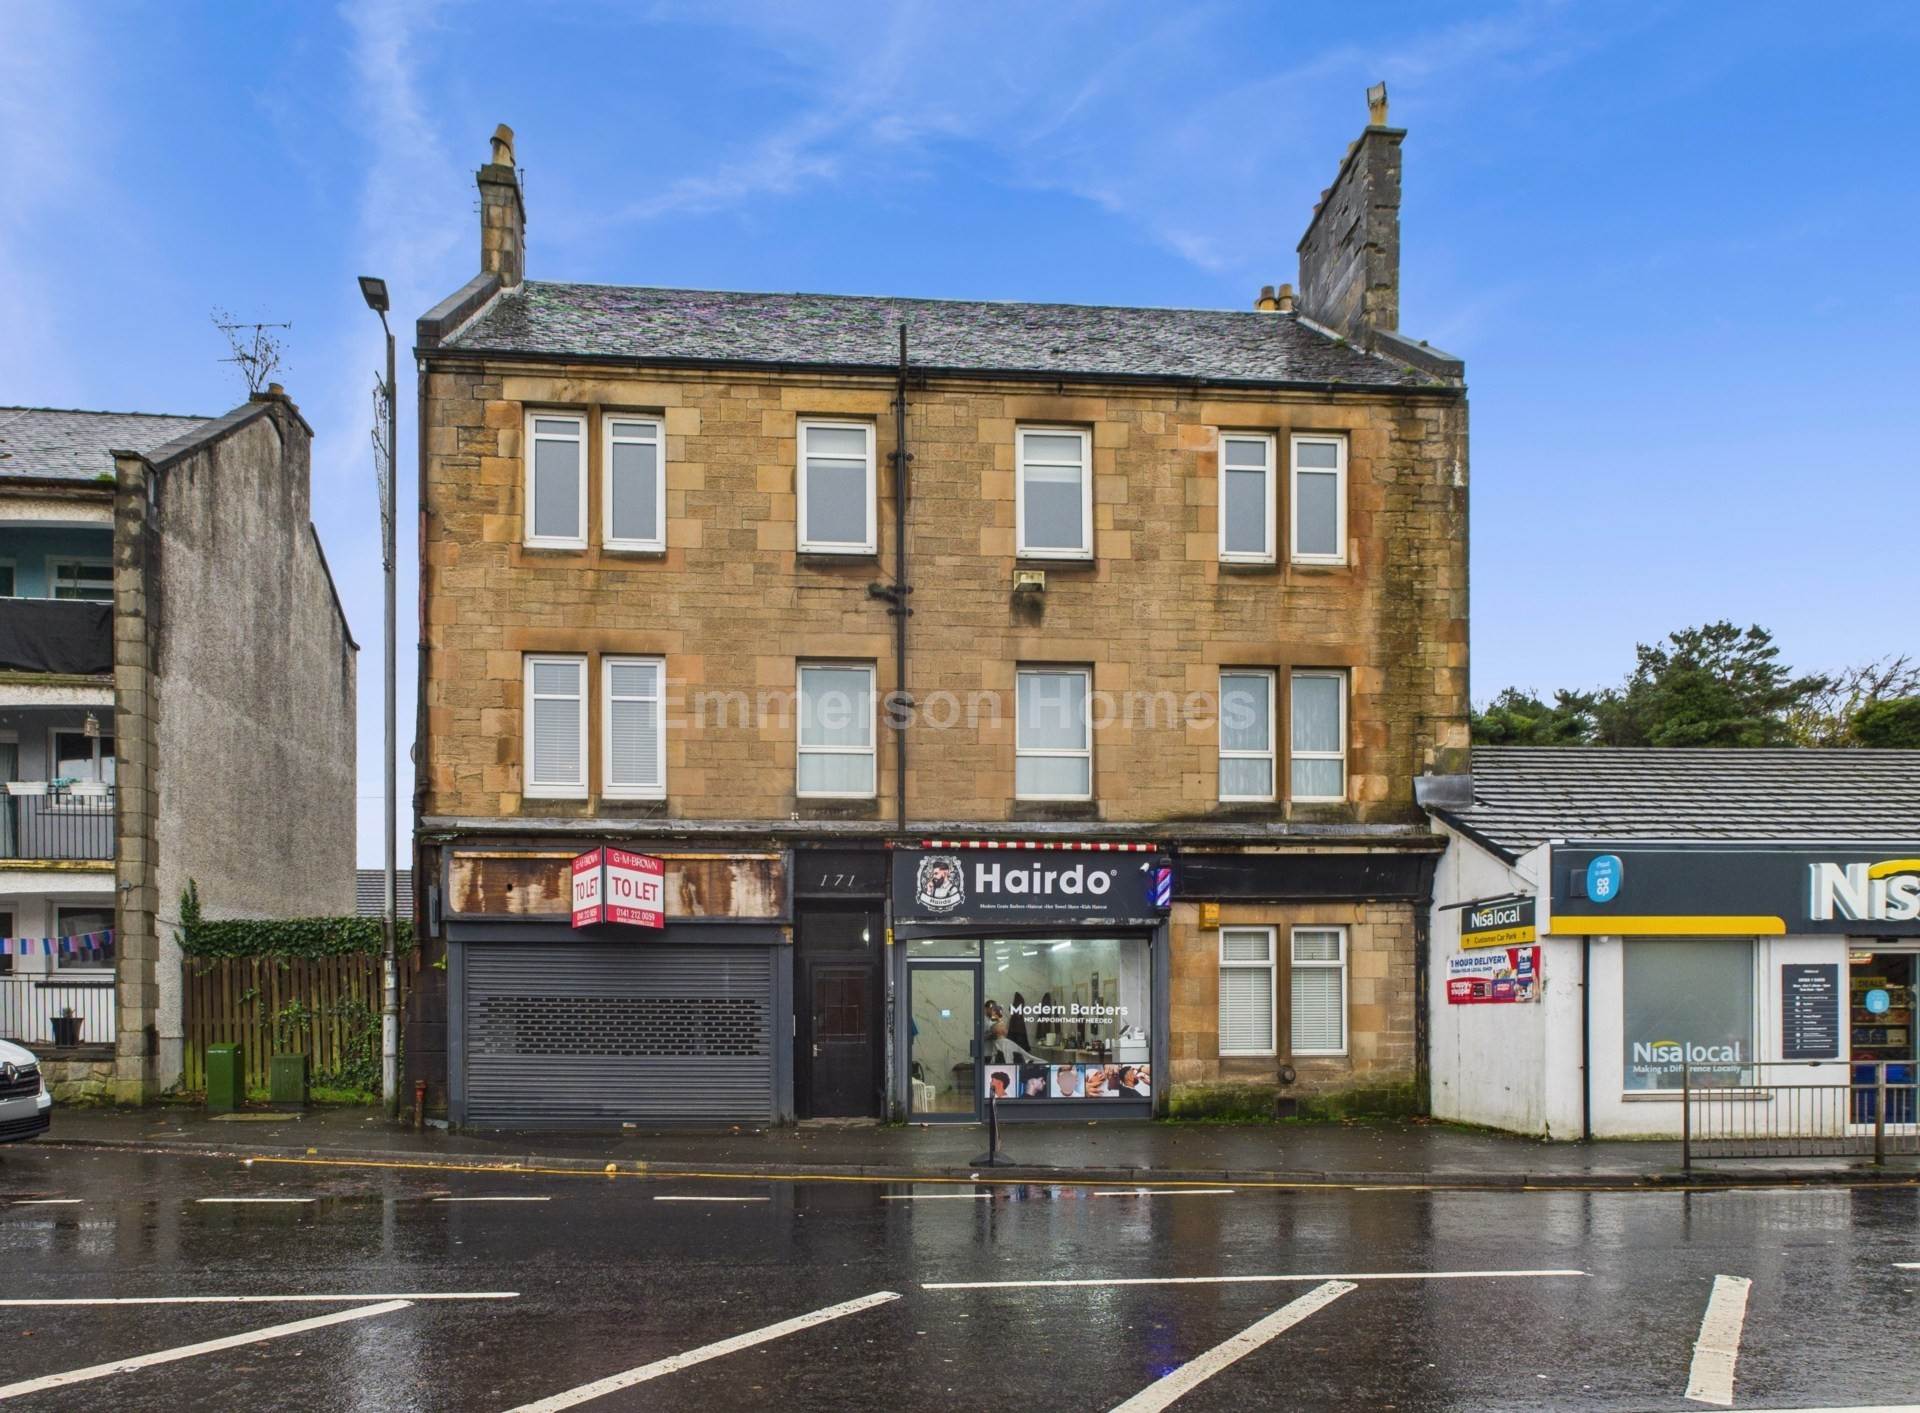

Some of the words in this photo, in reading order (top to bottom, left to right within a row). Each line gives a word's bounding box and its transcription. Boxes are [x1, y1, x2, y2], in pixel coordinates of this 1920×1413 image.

[820, 874, 855, 887] 171
[576, 881, 584, 901] TO
[586, 876, 599, 898] LET
[612, 876, 631, 897] TO
[635, 881, 659, 902] LET
[1474, 935, 1496, 944] Customer
[1506, 932, 1516, 940] Park
[1455, 958, 1474, 967] HOUR
[1475, 955, 1507, 966] DELIVERY
[1010, 1003, 1066, 1015] Modern
[1071, 1003, 1128, 1016] Barbers
[1633, 1065, 1662, 1075] Making
[1669, 1065, 1711, 1073] Diffrence
[1712, 1065, 1741, 1074] Locally
